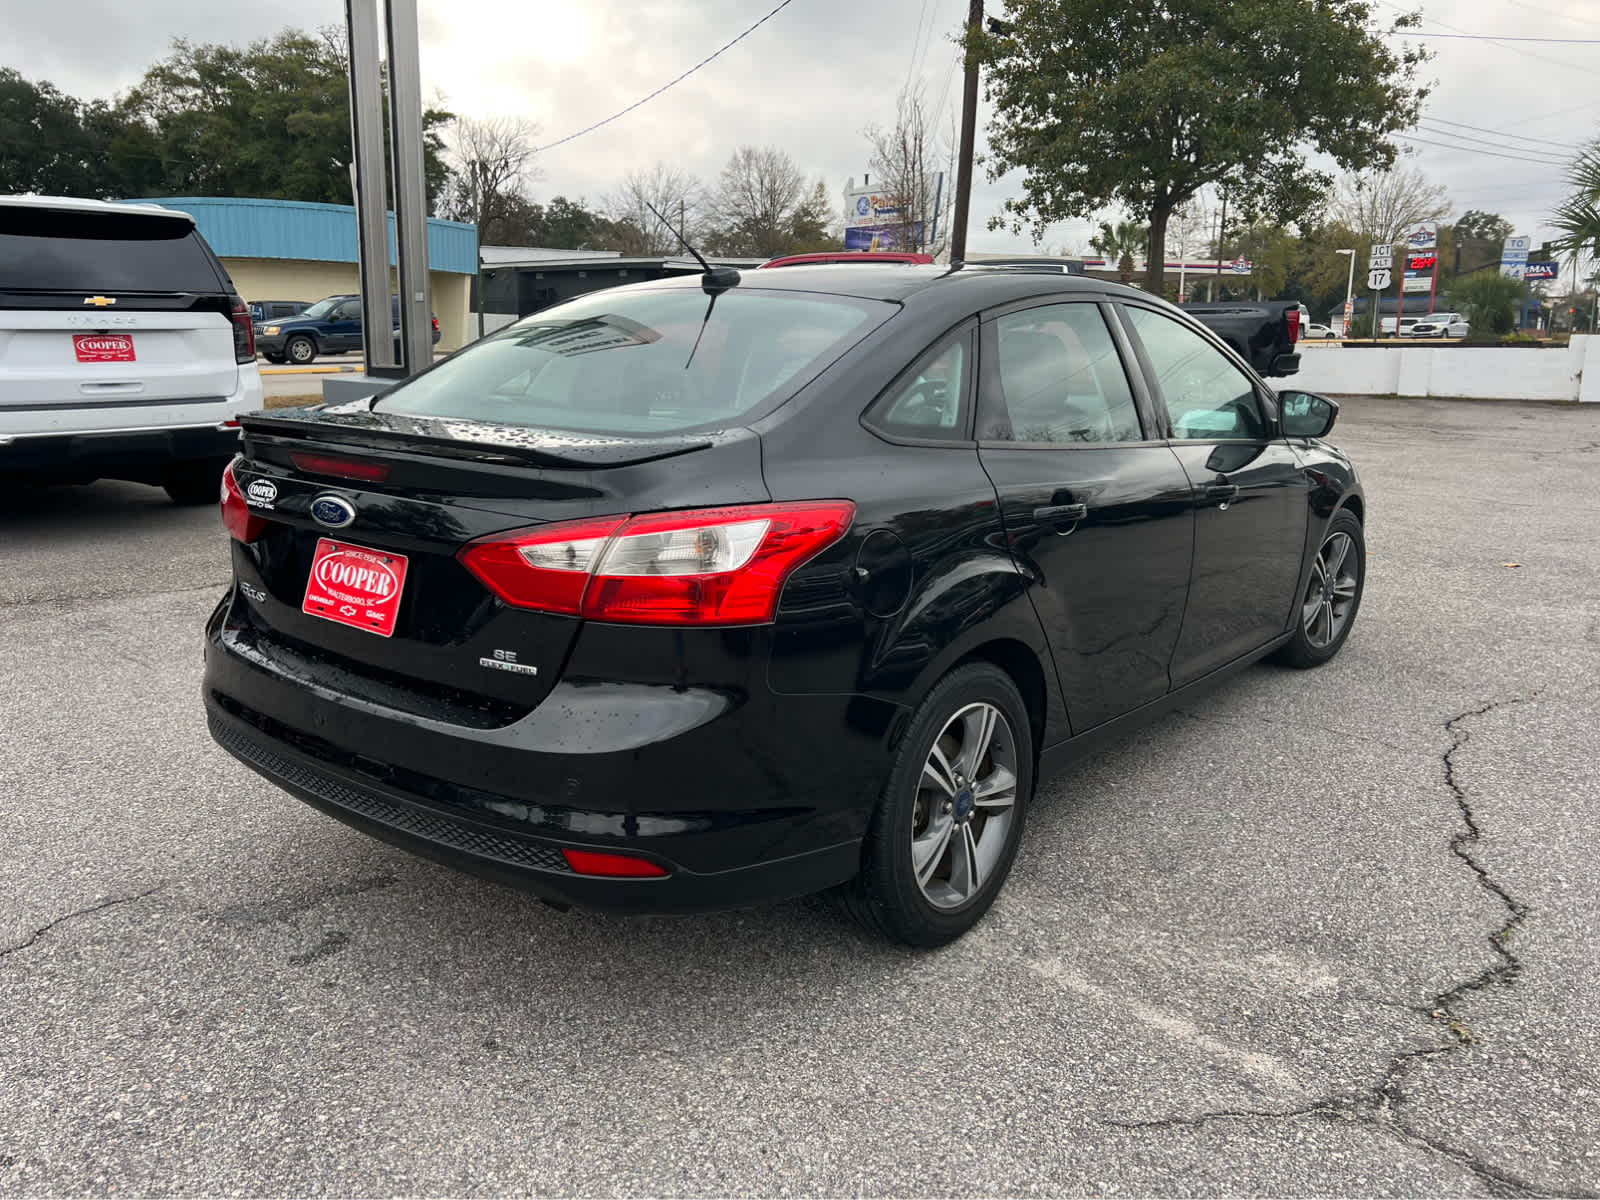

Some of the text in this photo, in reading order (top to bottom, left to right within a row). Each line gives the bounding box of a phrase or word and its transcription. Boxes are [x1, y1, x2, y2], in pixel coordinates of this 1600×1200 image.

[1510, 239, 1524, 248] TO
[1372, 245, 1391, 256] JCT
[1373, 259, 1388, 267] ALT
[1374, 273, 1386, 286] 17
[80, 341, 127, 350] COOPER
[250, 484, 274, 498] COOPER
[320, 559, 391, 597] COOPER
[366, 609, 387, 621] GMC
[493, 649, 517, 662] SE
